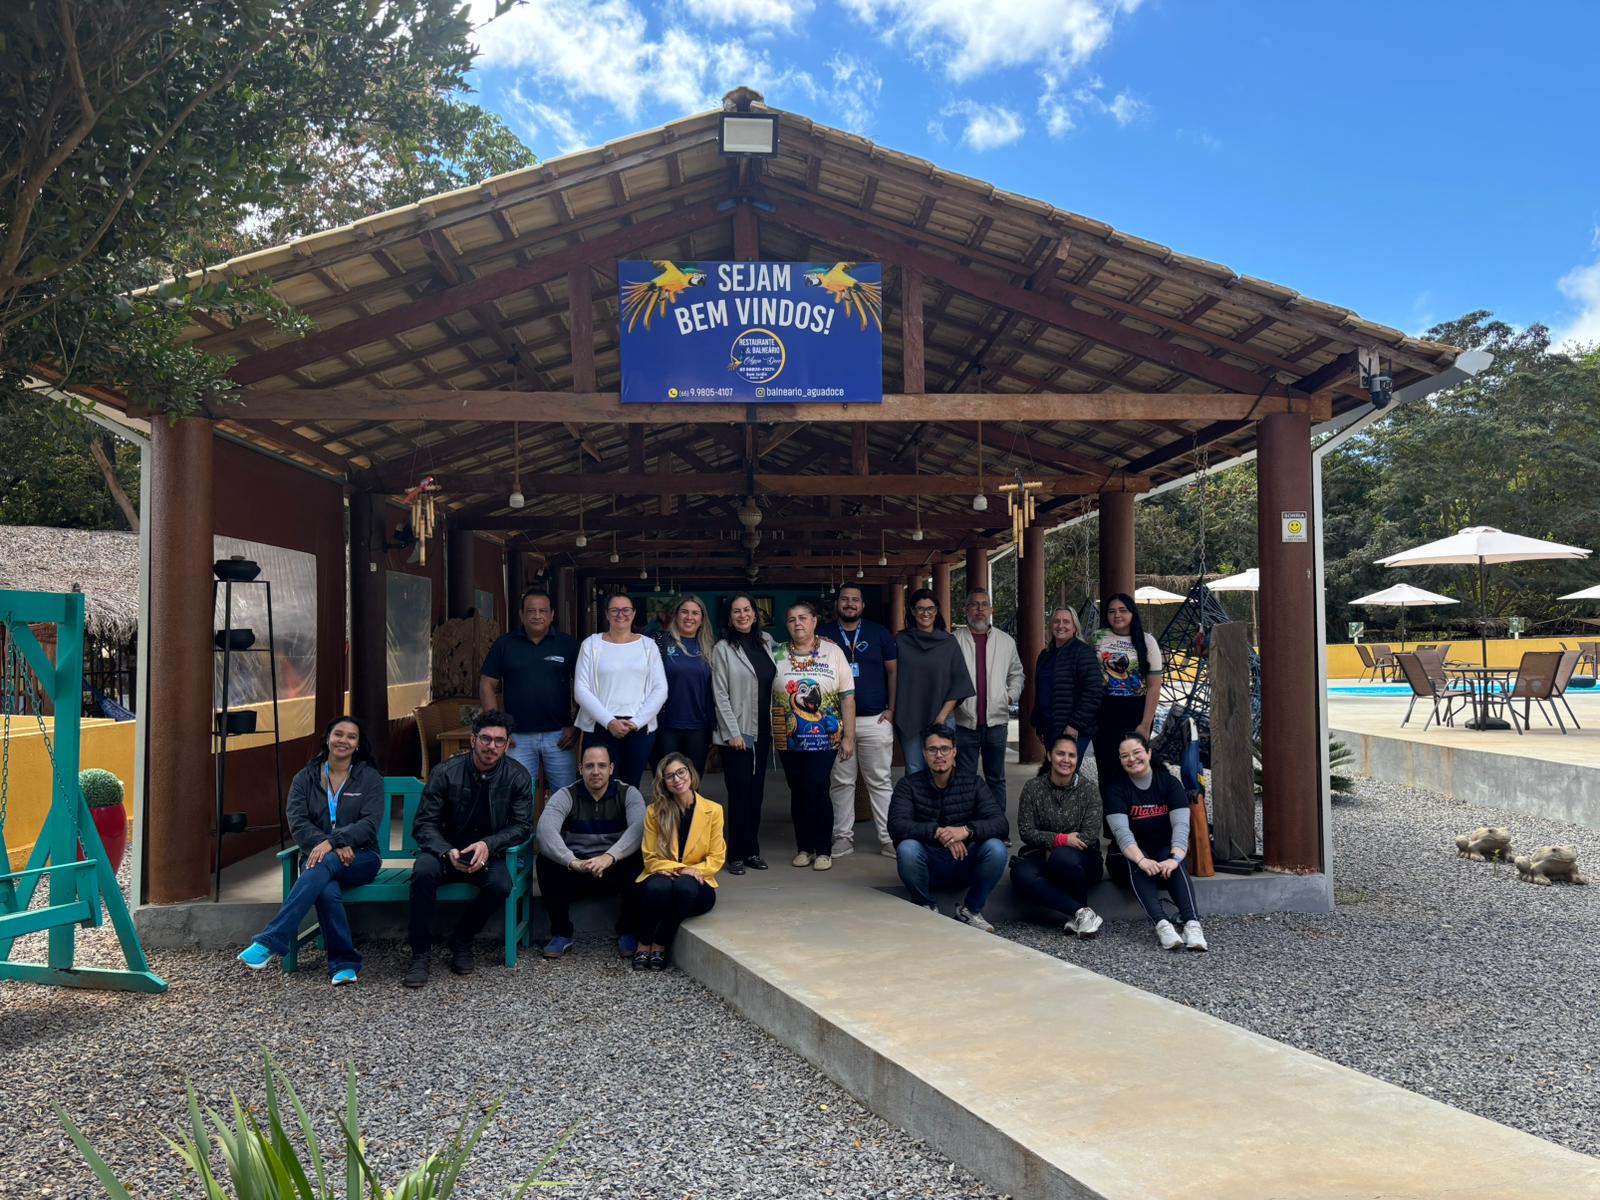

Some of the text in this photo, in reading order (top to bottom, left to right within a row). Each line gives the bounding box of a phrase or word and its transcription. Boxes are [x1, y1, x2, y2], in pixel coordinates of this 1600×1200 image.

[718, 264, 791, 292] SEJAM
[674, 297, 835, 335] BEM VINDOS!
[739, 338, 775, 346] RESTAURANTE
[690, 387, 733, 397] 9.9805-4107
[766, 387, 845, 398] balneario_aguadoce
